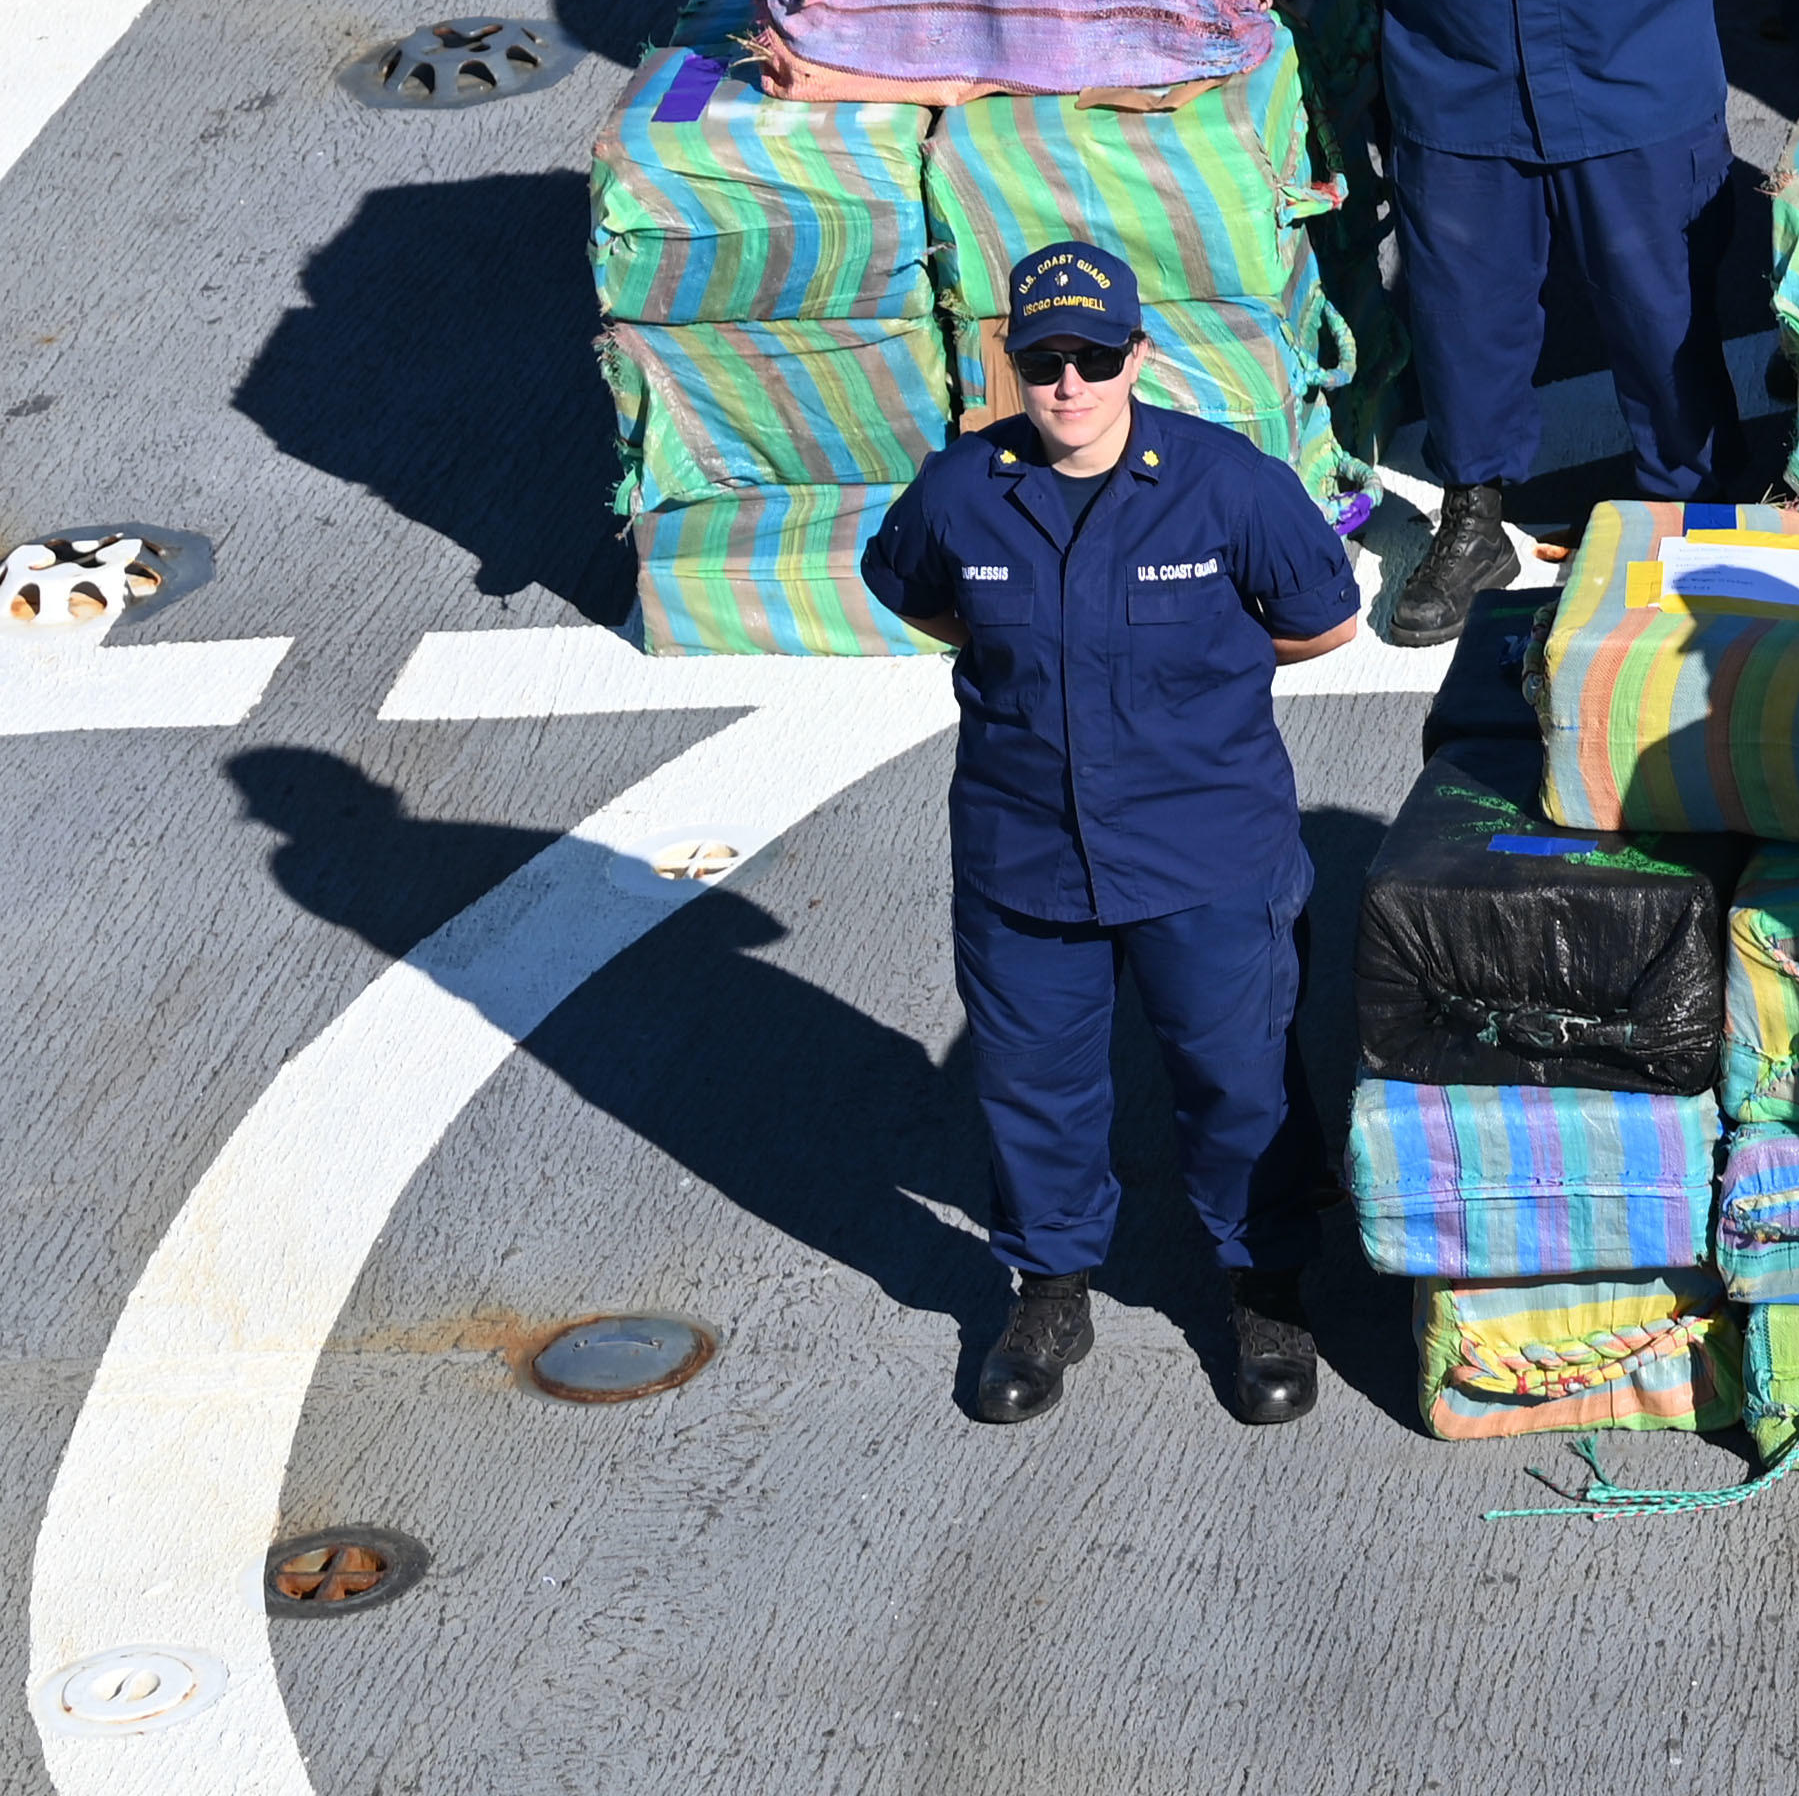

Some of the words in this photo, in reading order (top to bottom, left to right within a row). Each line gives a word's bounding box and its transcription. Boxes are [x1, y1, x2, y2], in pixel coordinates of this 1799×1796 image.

[1018, 275, 1037, 295] U.S.
[1037, 253, 1074, 276] COAST
[1076, 259, 1111, 289] GUARD
[1023, 297, 1051, 317] USCGC
[1052, 295, 1106, 312] CAMPBELL
[962, 565, 1009, 581] DUPLESSIS
[1137, 565, 1159, 582] U.S.
[1159, 563, 1193, 581] COAST
[1193, 557, 1218, 578] GUARD
